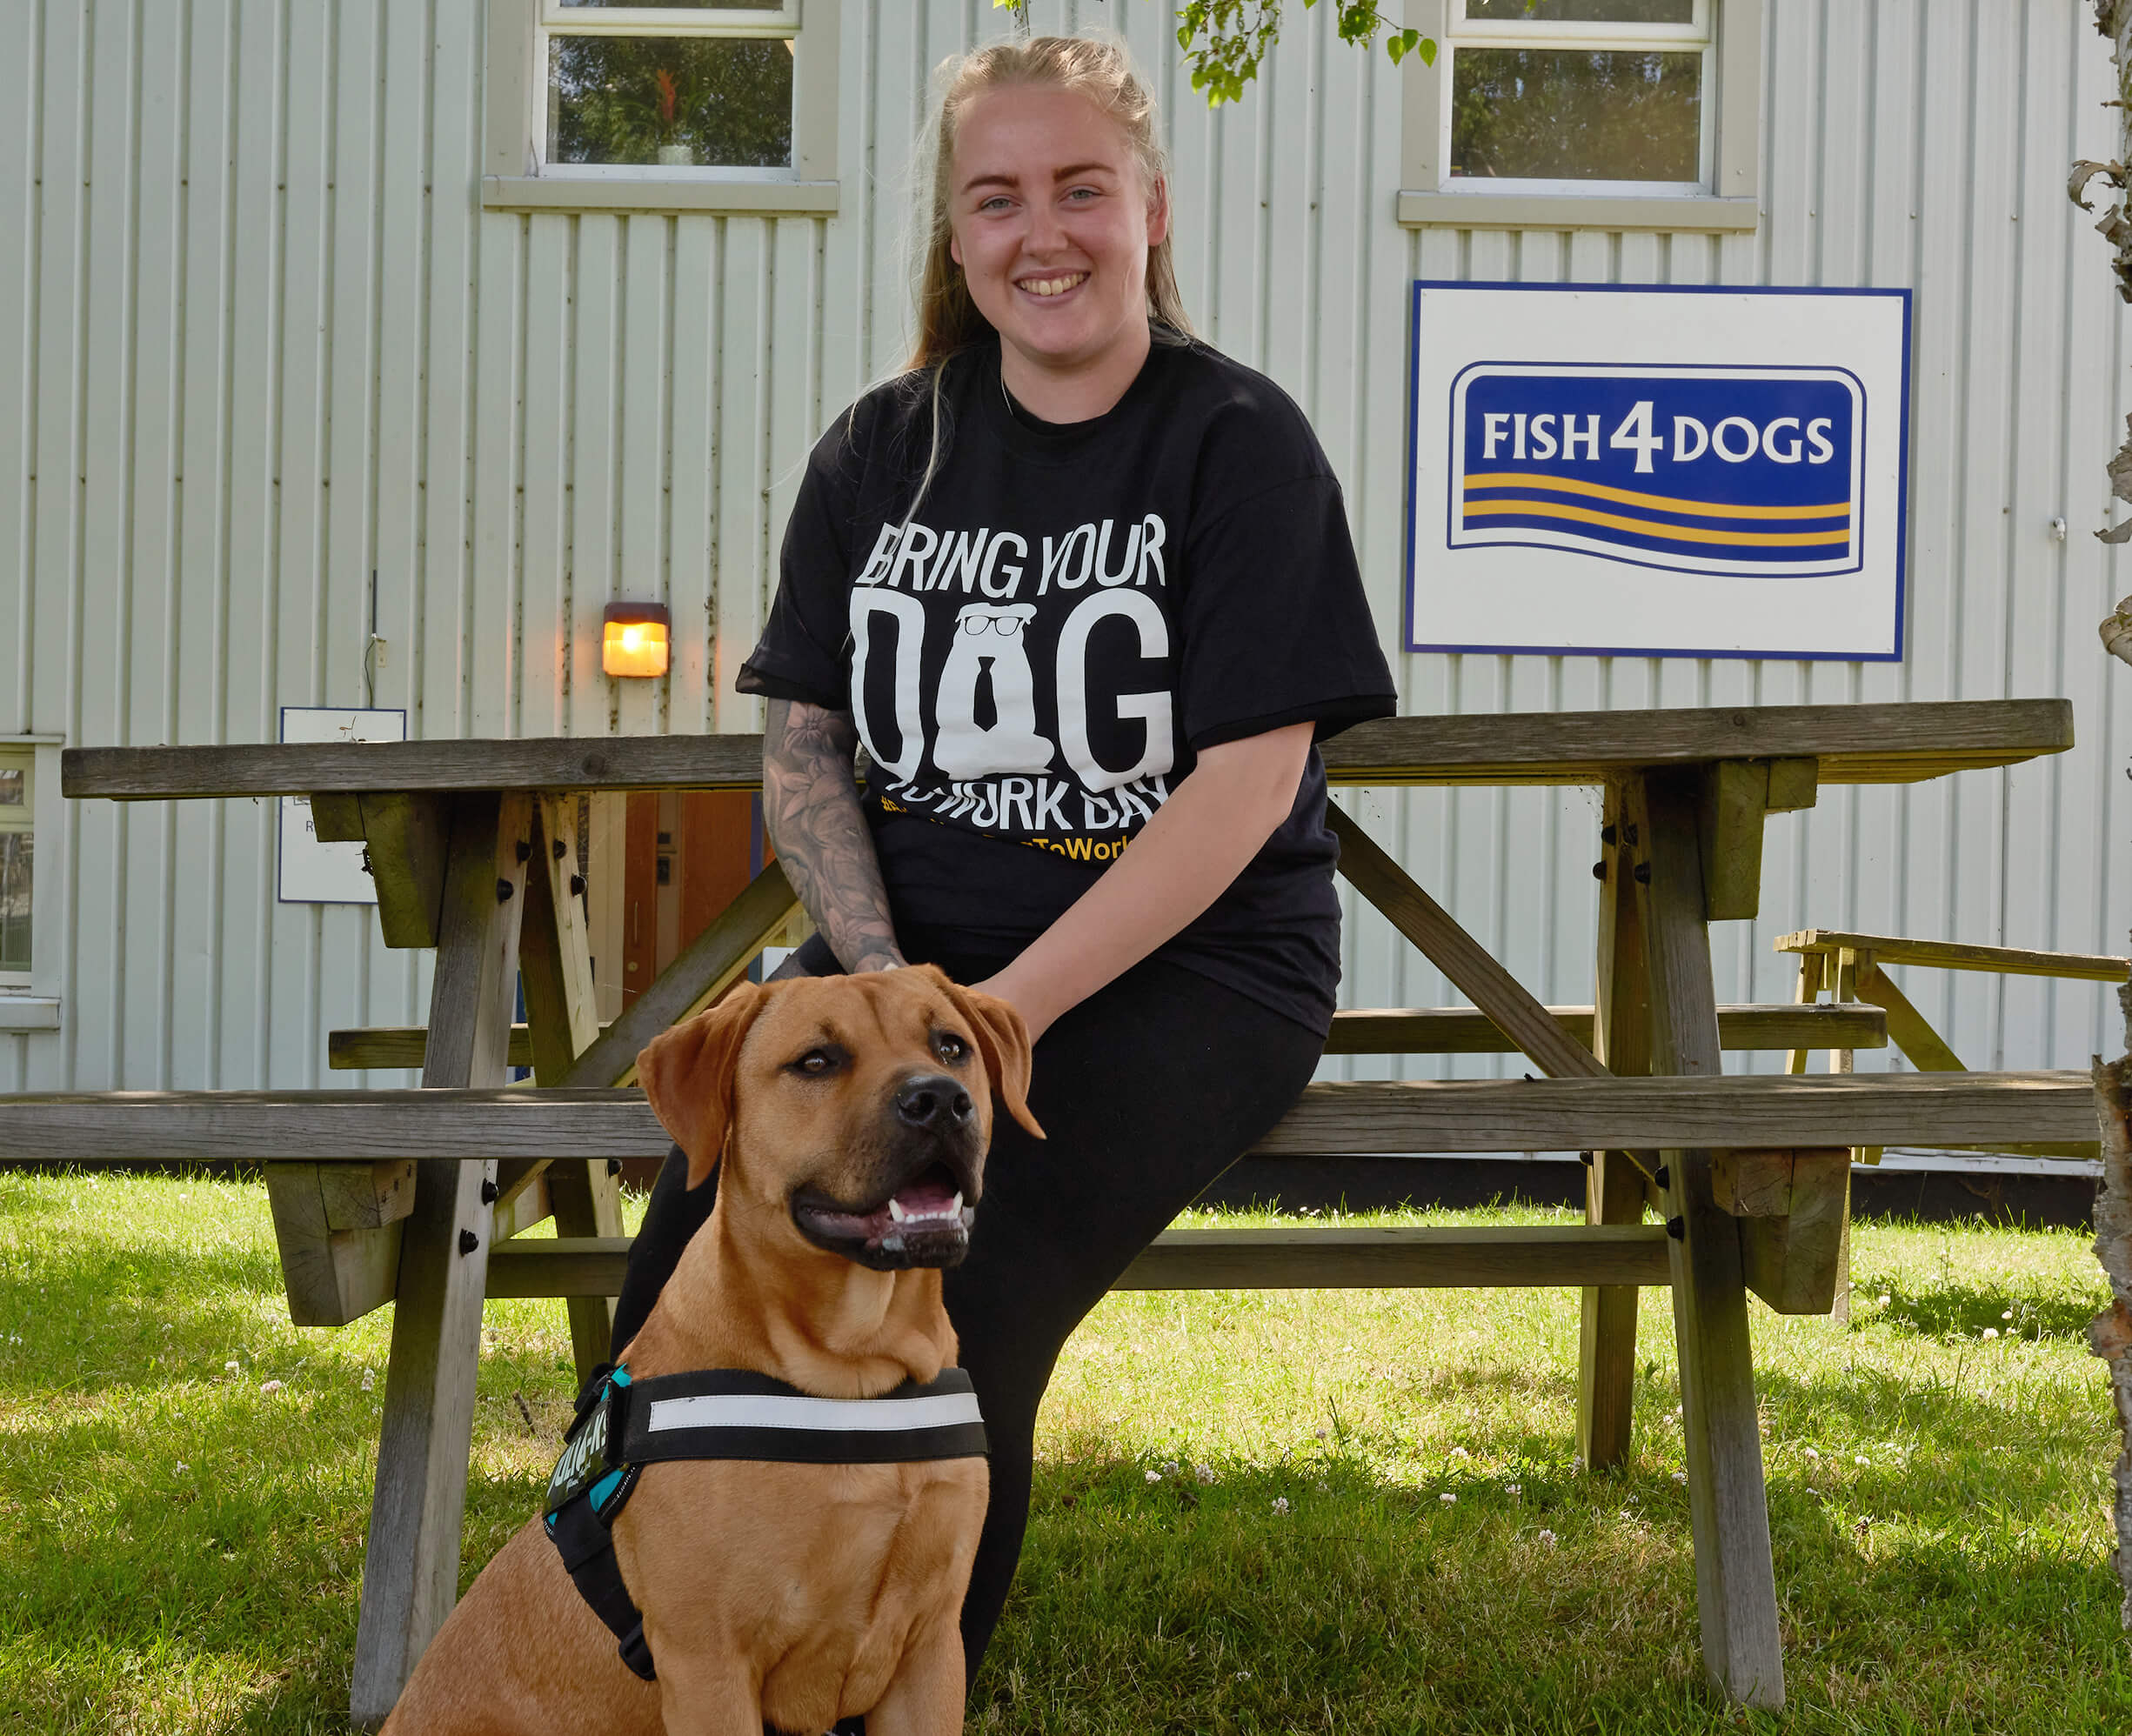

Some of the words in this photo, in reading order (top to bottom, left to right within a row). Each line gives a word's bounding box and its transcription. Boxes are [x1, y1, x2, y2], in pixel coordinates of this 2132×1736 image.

[855, 522, 1027, 598] BRING
[1037, 513, 1166, 597] YOUR
[932, 777, 1073, 830] WORK
